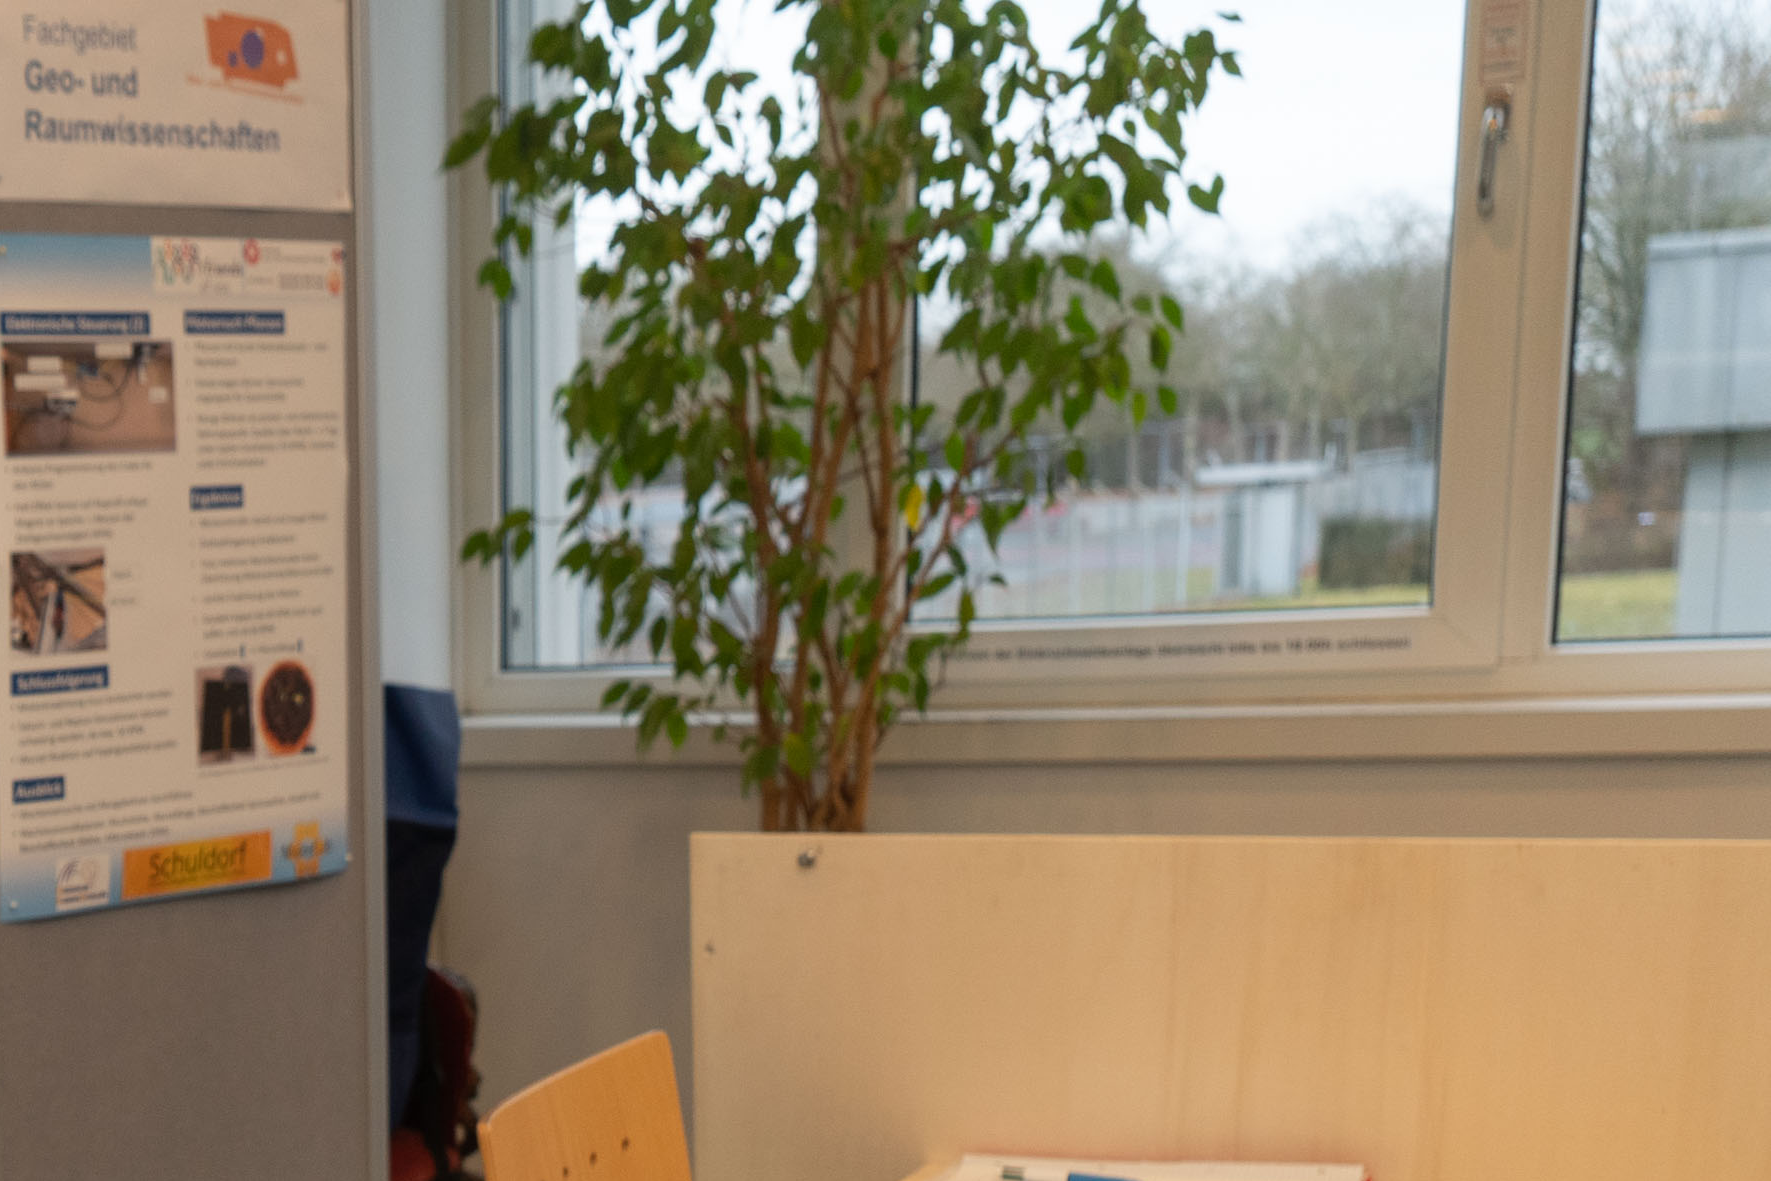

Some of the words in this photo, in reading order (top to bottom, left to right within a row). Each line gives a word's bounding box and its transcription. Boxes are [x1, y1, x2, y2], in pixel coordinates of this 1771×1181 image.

[23, 15, 137, 53] Fachgebiet
[24, 59, 85, 94] Geo-
[91, 67, 138, 97] und
[24, 109, 281, 151] Raumwissenschaften
[149, 840, 248, 877] Schuldorf
